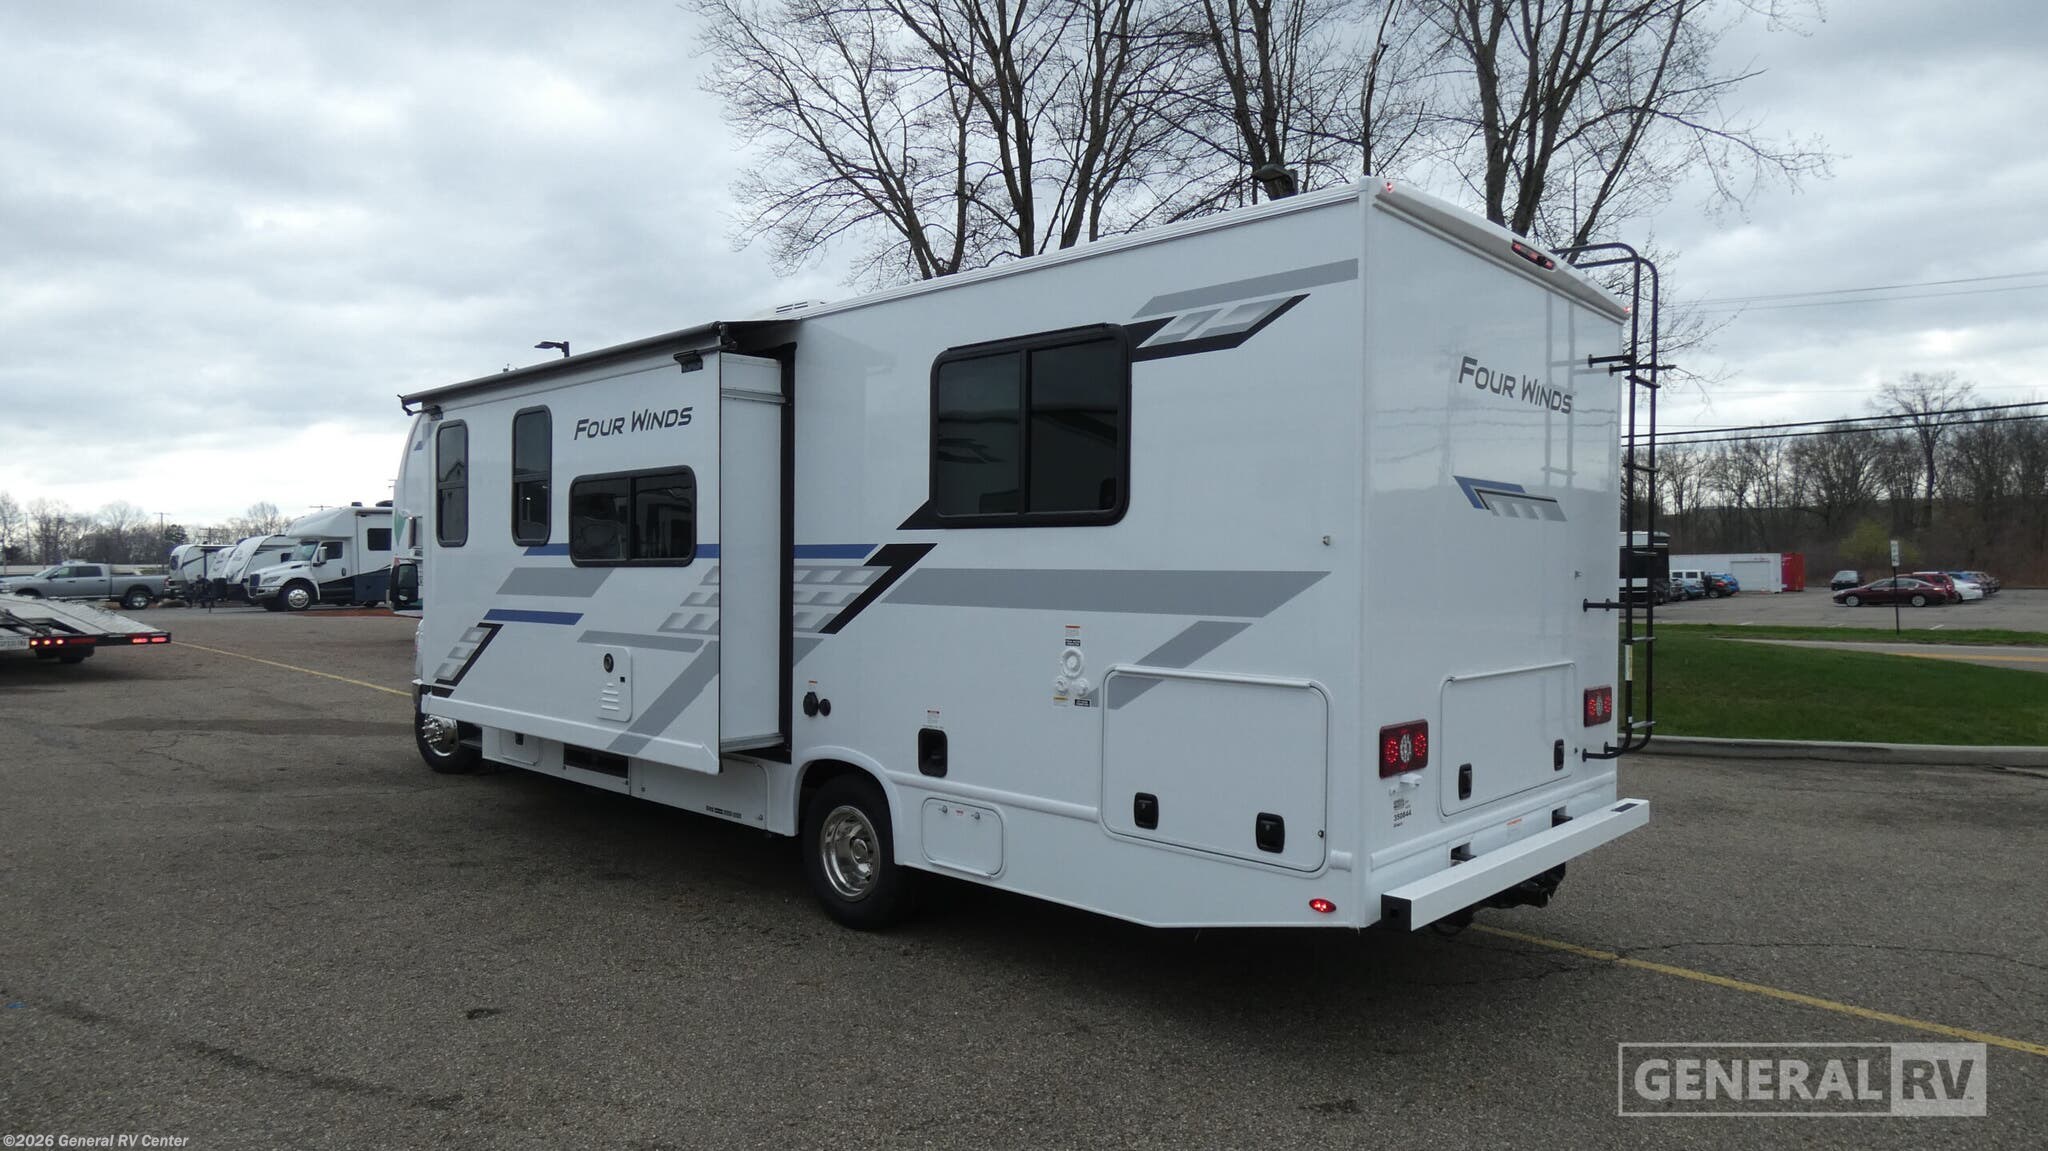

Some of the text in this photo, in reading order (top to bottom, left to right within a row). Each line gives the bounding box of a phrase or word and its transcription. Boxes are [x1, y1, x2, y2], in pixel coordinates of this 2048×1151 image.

[1458, 356, 1573, 414] FOUR WINDS
[574, 406, 693, 440] FOUR WINDS
